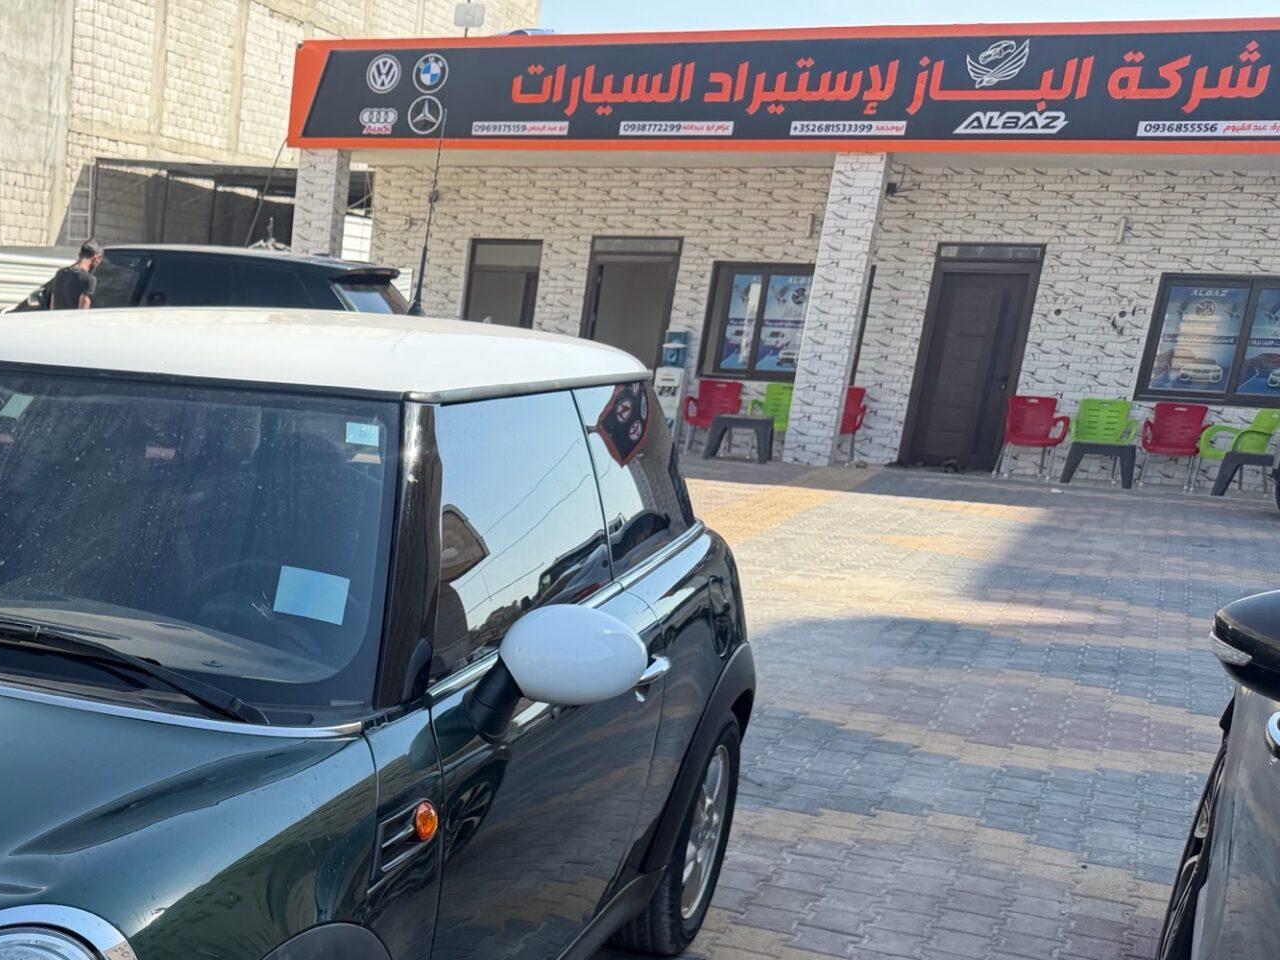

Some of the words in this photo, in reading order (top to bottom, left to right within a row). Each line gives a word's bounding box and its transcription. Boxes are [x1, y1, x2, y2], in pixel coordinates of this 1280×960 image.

[1108, 40, 1271, 114] شركة
[511, 61, 696, 115] السيارات
[623, 123, 682, 132] 0938772299
[961, 113, 1062, 131] ALBAZ
[1143, 123, 1218, 133] 0936855556
